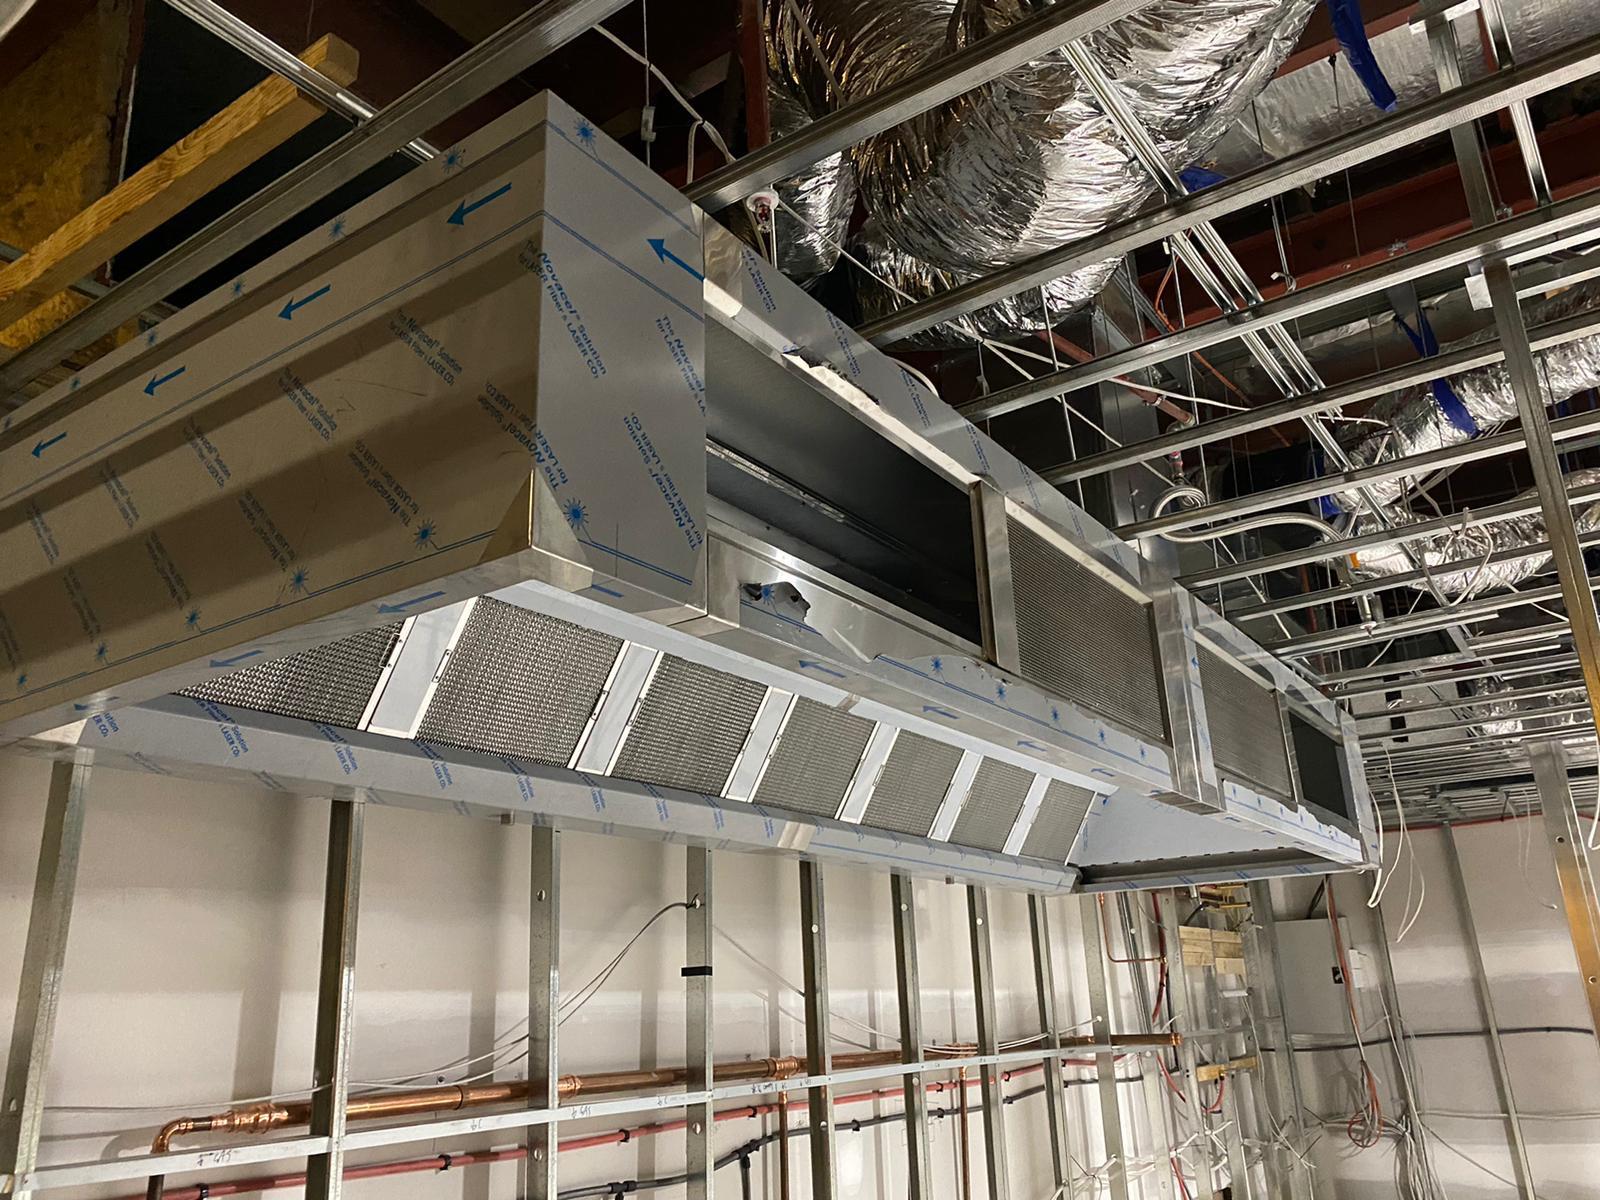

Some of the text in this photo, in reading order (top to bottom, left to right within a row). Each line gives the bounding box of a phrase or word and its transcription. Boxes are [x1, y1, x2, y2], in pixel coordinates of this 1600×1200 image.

[546, 284, 565, 313] Fiber
[566, 321, 589, 358] LASER
[662, 314, 675, 336] The
[577, 323, 607, 375] Solution
[655, 317, 666, 333] for
[663, 333, 683, 366] LASER
[533, 429, 559, 467] LASER
[622, 415, 651, 465] Solution
[640, 431, 662, 465] LASER
[544, 465, 560, 492] The
[556, 467, 569, 485] for
[663, 472, 679, 498] Fiber
[676, 497, 696, 530] LASER
[684, 528, 698, 552] The
[693, 529, 704, 545] for
